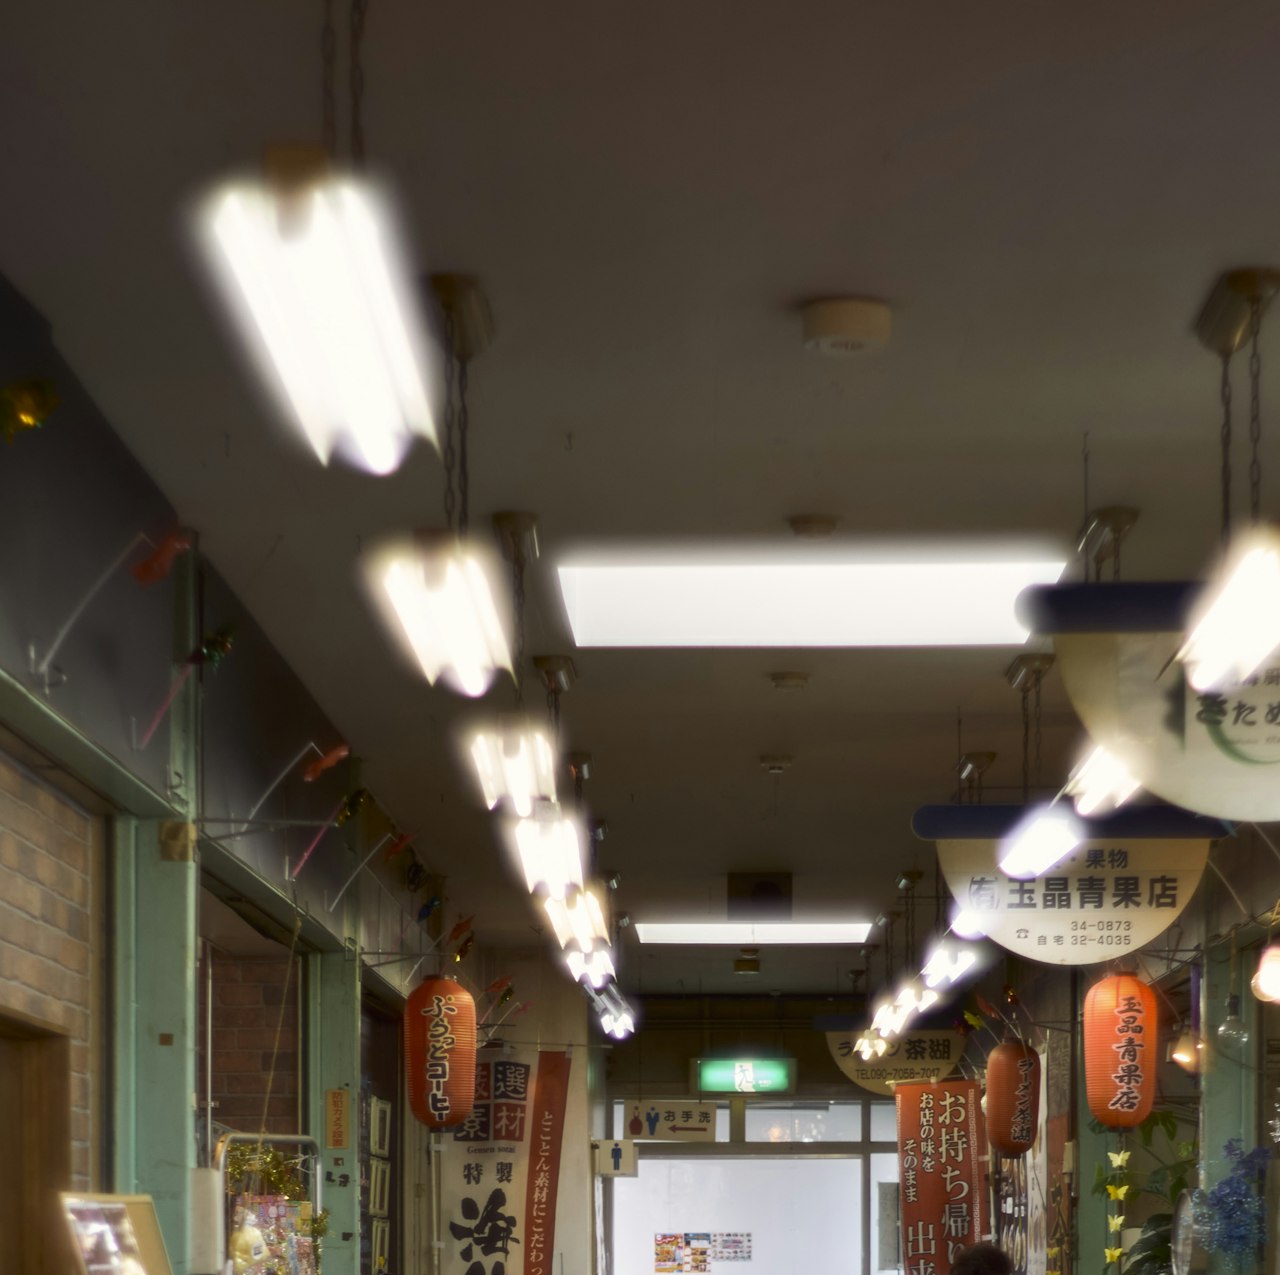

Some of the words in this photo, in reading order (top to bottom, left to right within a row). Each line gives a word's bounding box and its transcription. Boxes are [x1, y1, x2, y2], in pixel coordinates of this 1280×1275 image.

[1037, 935, 1064, 946] 自宅
[1108, 997, 1144, 1112] 玉晶青果店
[454, 1104, 526, 1142] 素材
[663, 1109, 712, 1124] お手洗
[1011, 1058, 1036, 1143] ラーメン茶湖
[919, 1093, 936, 1174] お店の味を
[463, 1161, 514, 1186] 特製
[903, 1141, 918, 1203] そのまま
